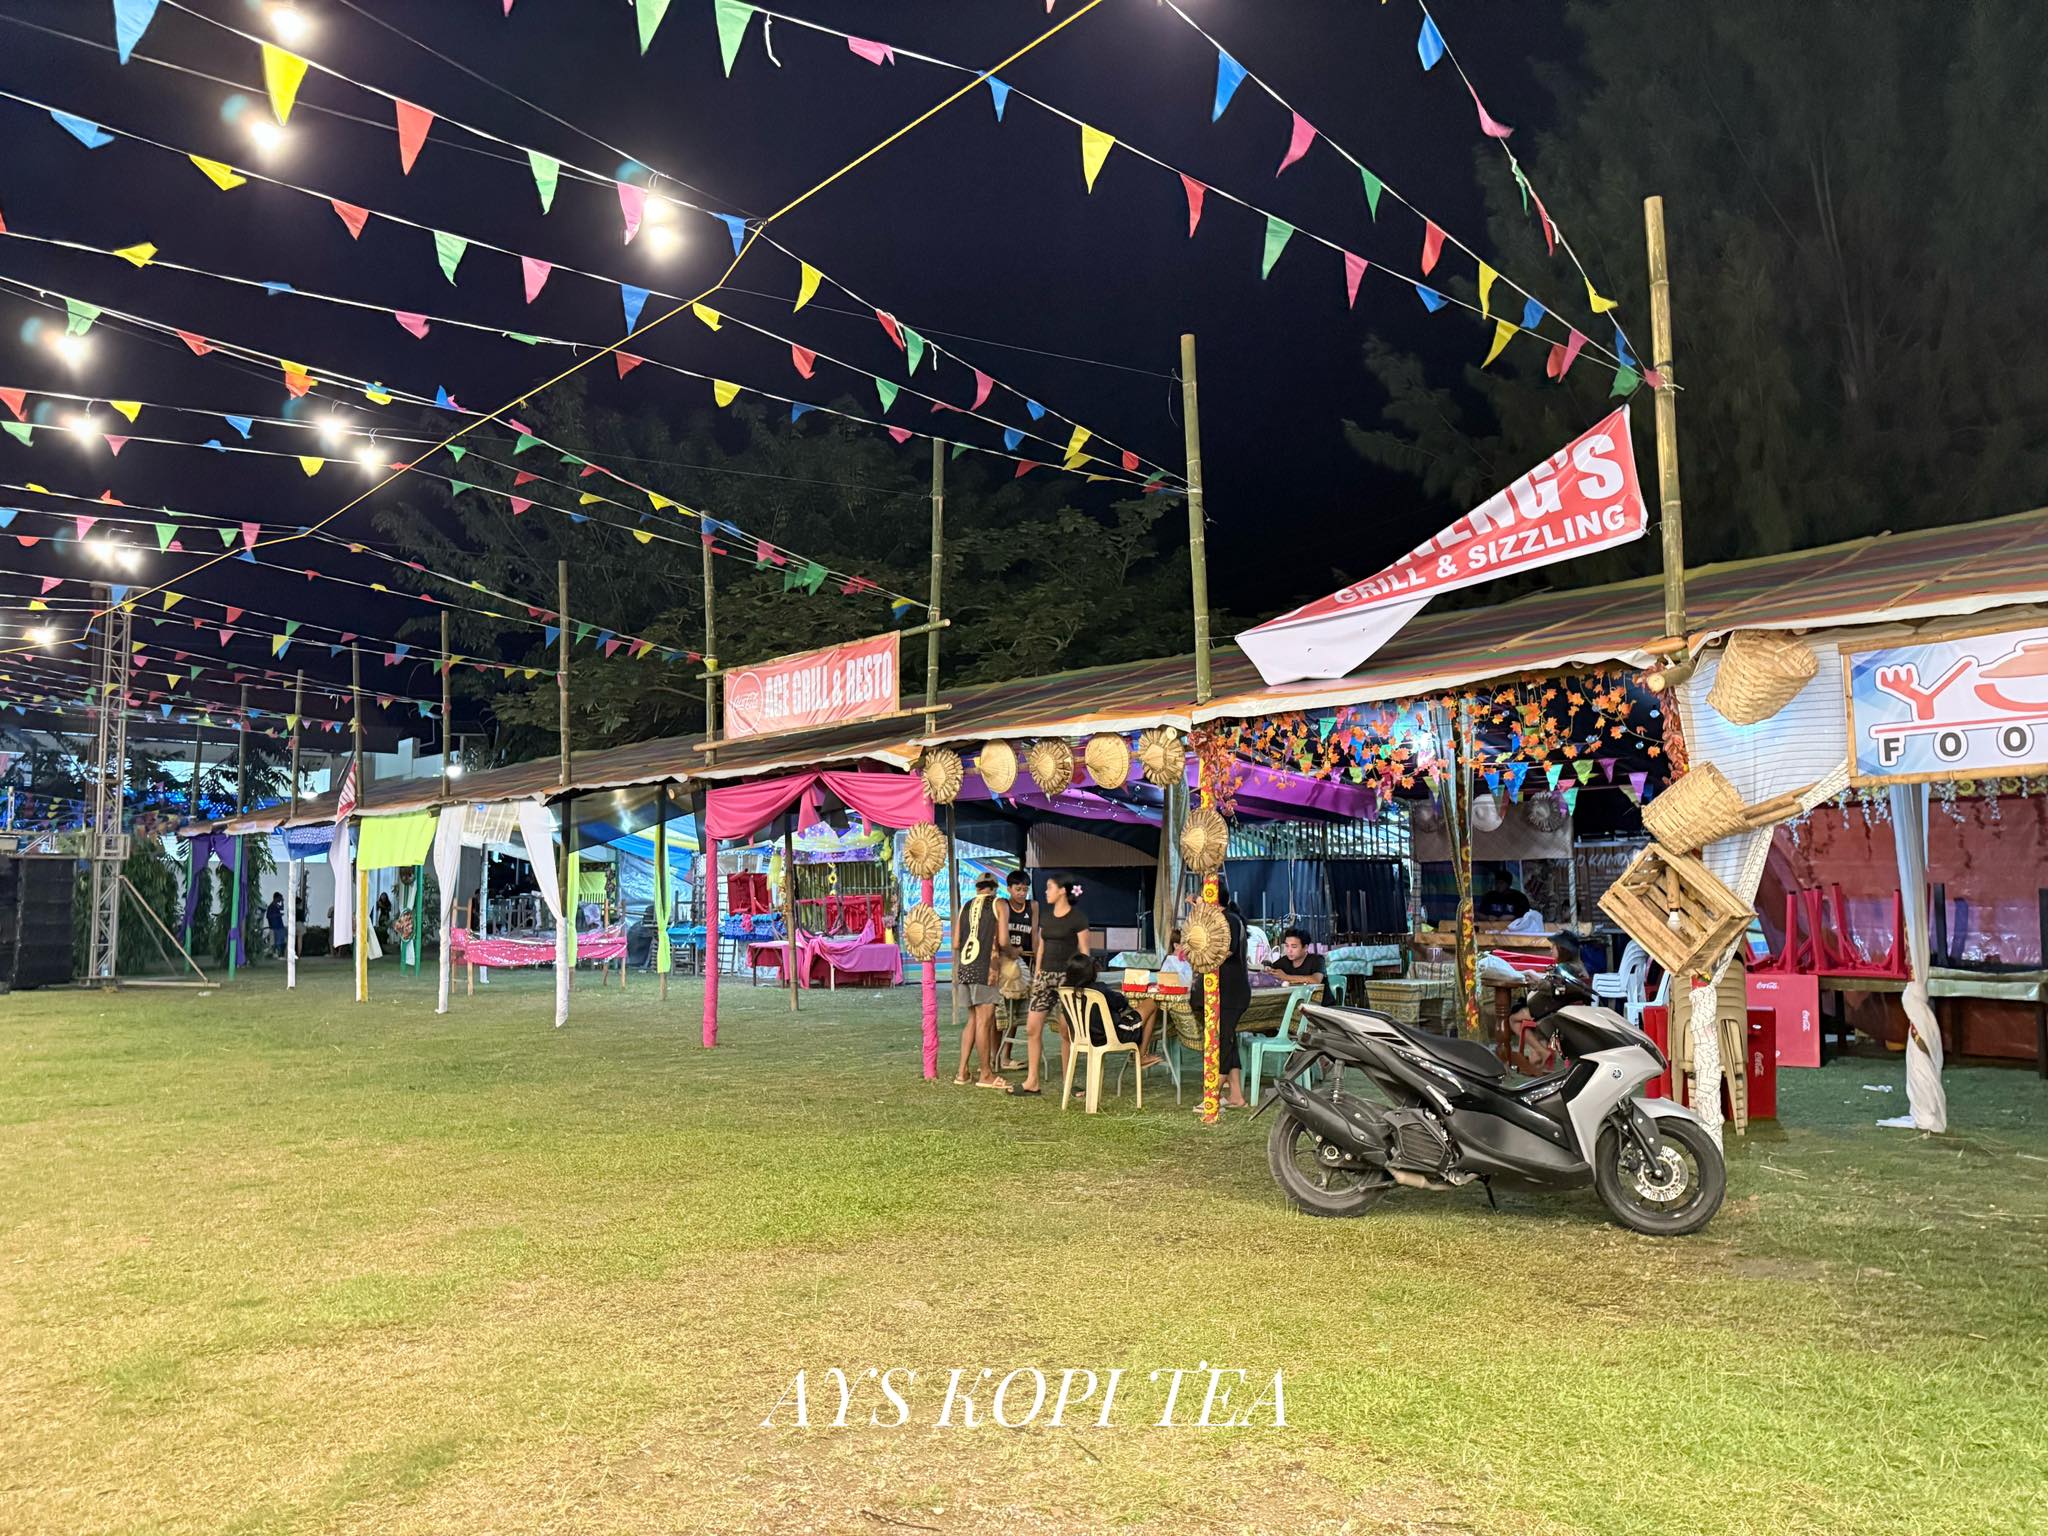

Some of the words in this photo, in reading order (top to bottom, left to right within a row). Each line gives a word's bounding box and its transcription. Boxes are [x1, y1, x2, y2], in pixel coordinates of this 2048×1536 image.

[1333, 567, 1426, 605] GRILL
[1436, 554, 1458, 579] &
[1468, 504, 1625, 569] SIZZLING
[765, 672, 790, 718] ACE
[792, 665, 829, 714] GRILL
[832, 668, 843, 707] &
[846, 650, 893, 705] RESTO
